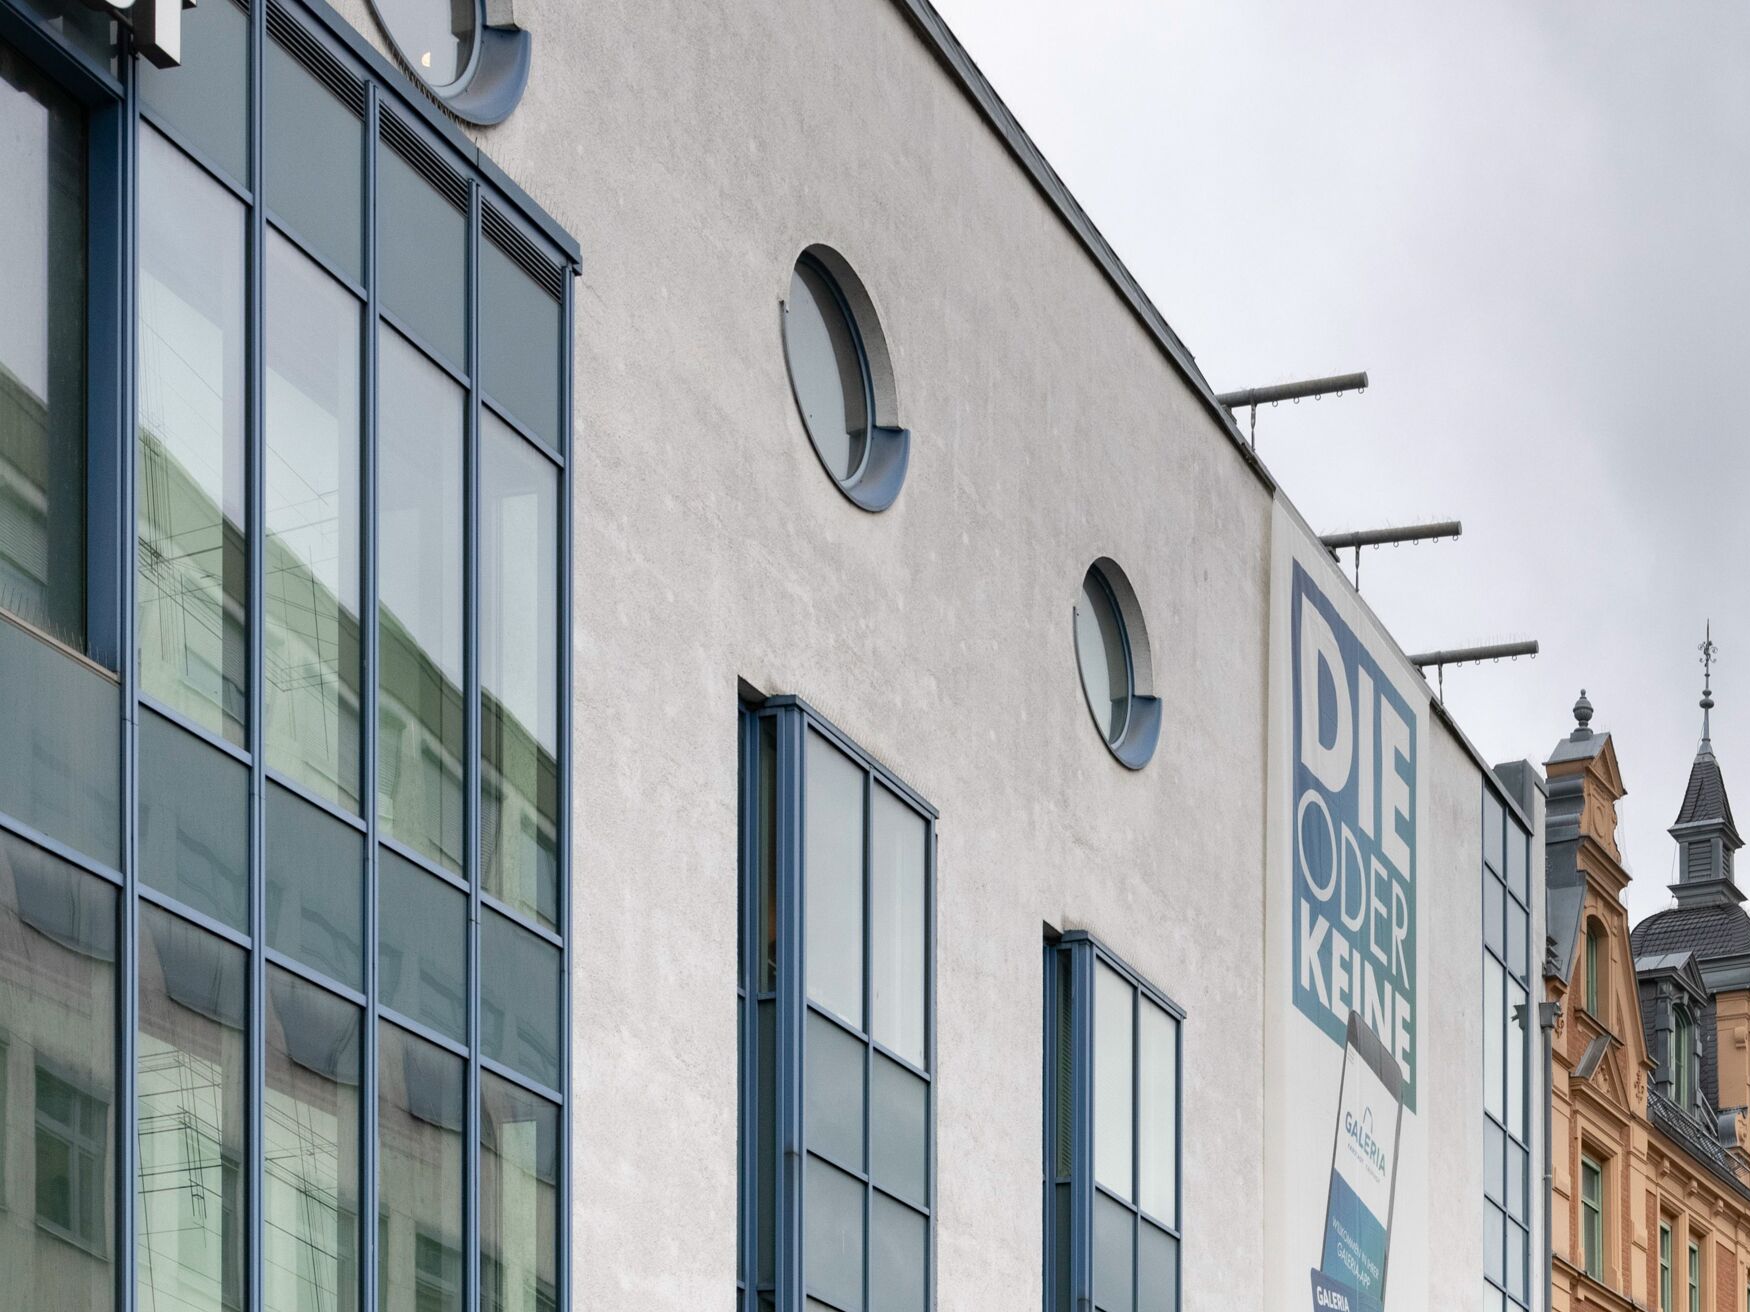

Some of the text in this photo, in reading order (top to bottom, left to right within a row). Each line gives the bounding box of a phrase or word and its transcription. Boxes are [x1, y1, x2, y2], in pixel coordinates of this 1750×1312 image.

[1301, 592, 1410, 882] DIE
[1299, 788, 1409, 990] ODER
[1300, 897, 1411, 1086] KEINE
[1332, 1215, 1361, 1258] WILLKOMMEN
[1344, 1111, 1387, 1177] GALERIA
